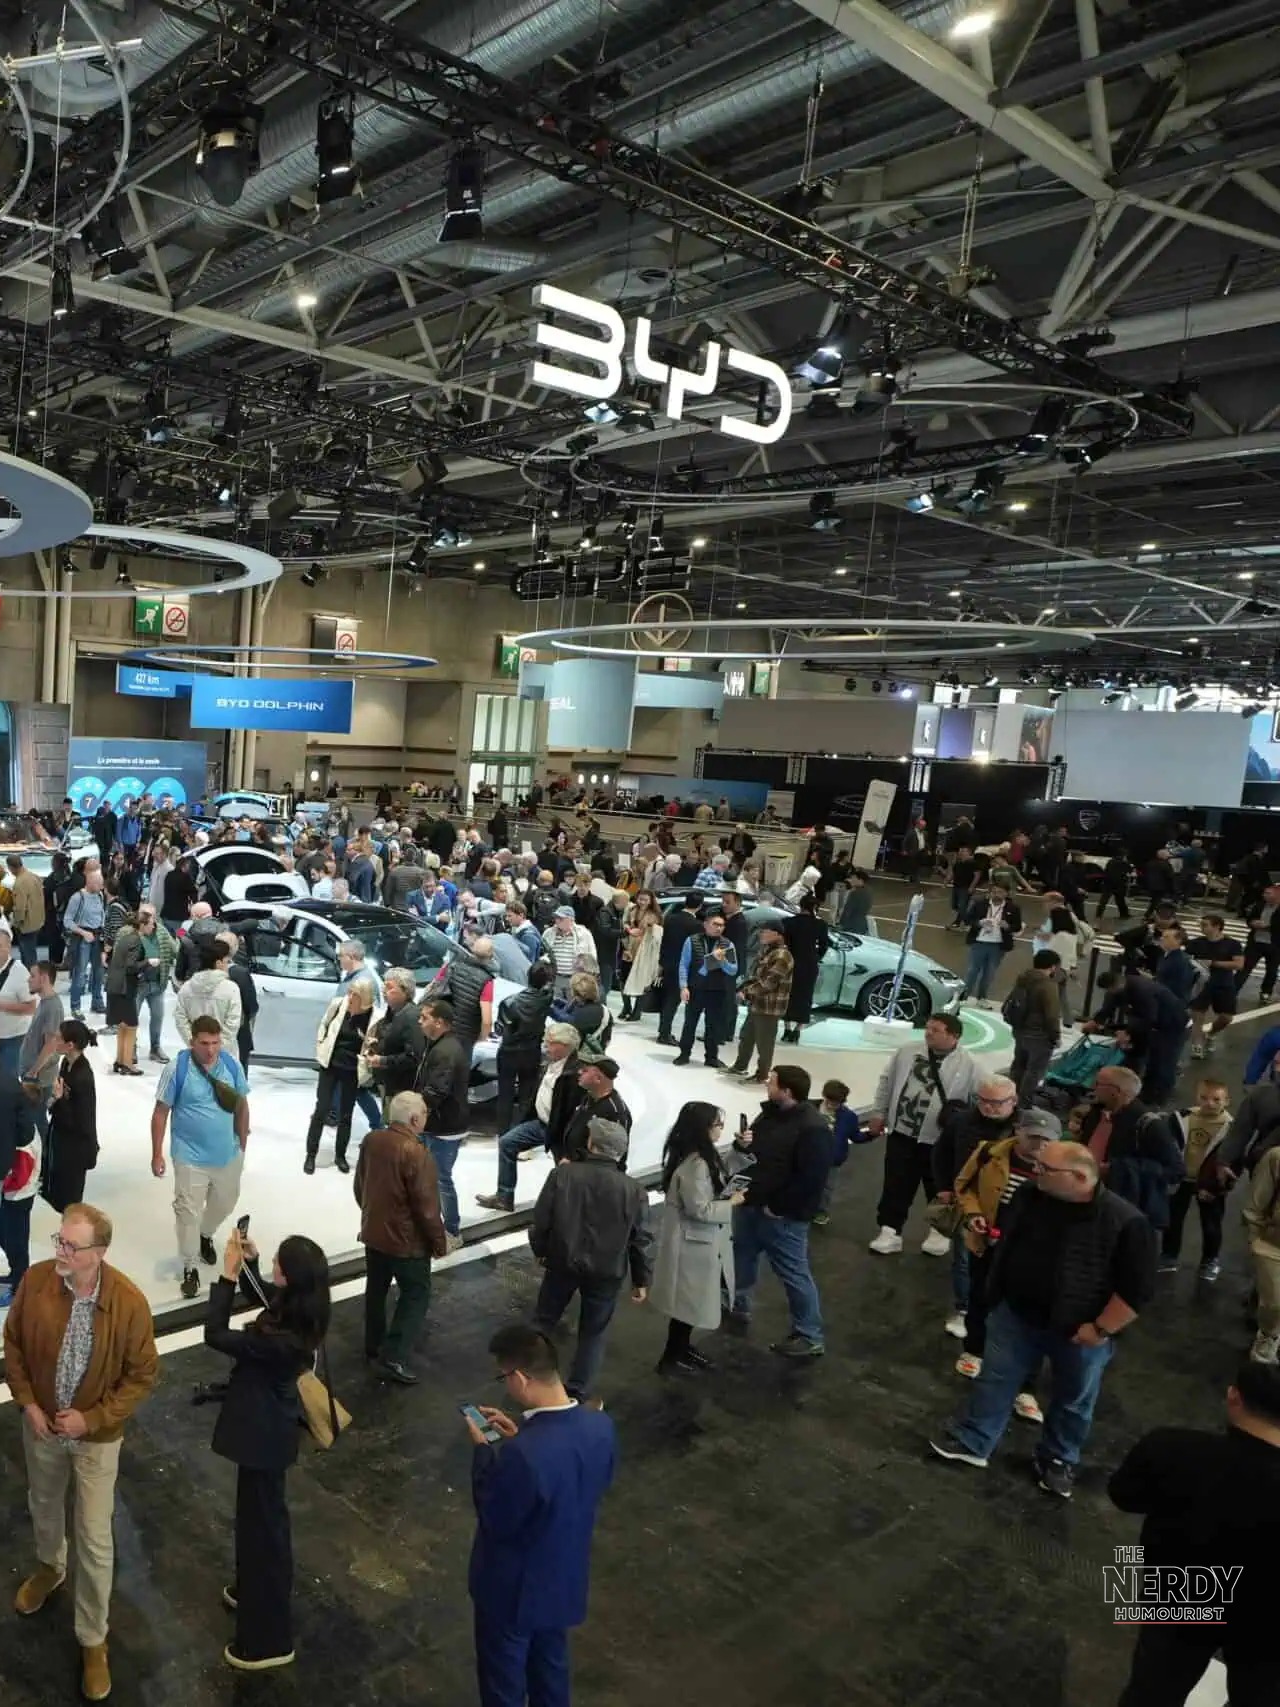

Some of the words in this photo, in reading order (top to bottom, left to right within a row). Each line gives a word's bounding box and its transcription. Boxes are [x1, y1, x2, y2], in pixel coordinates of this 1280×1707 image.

[532, 284, 792, 445] BYD
[216, 698, 249, 709] BYD
[253, 700, 324, 711] DOLPHIN
